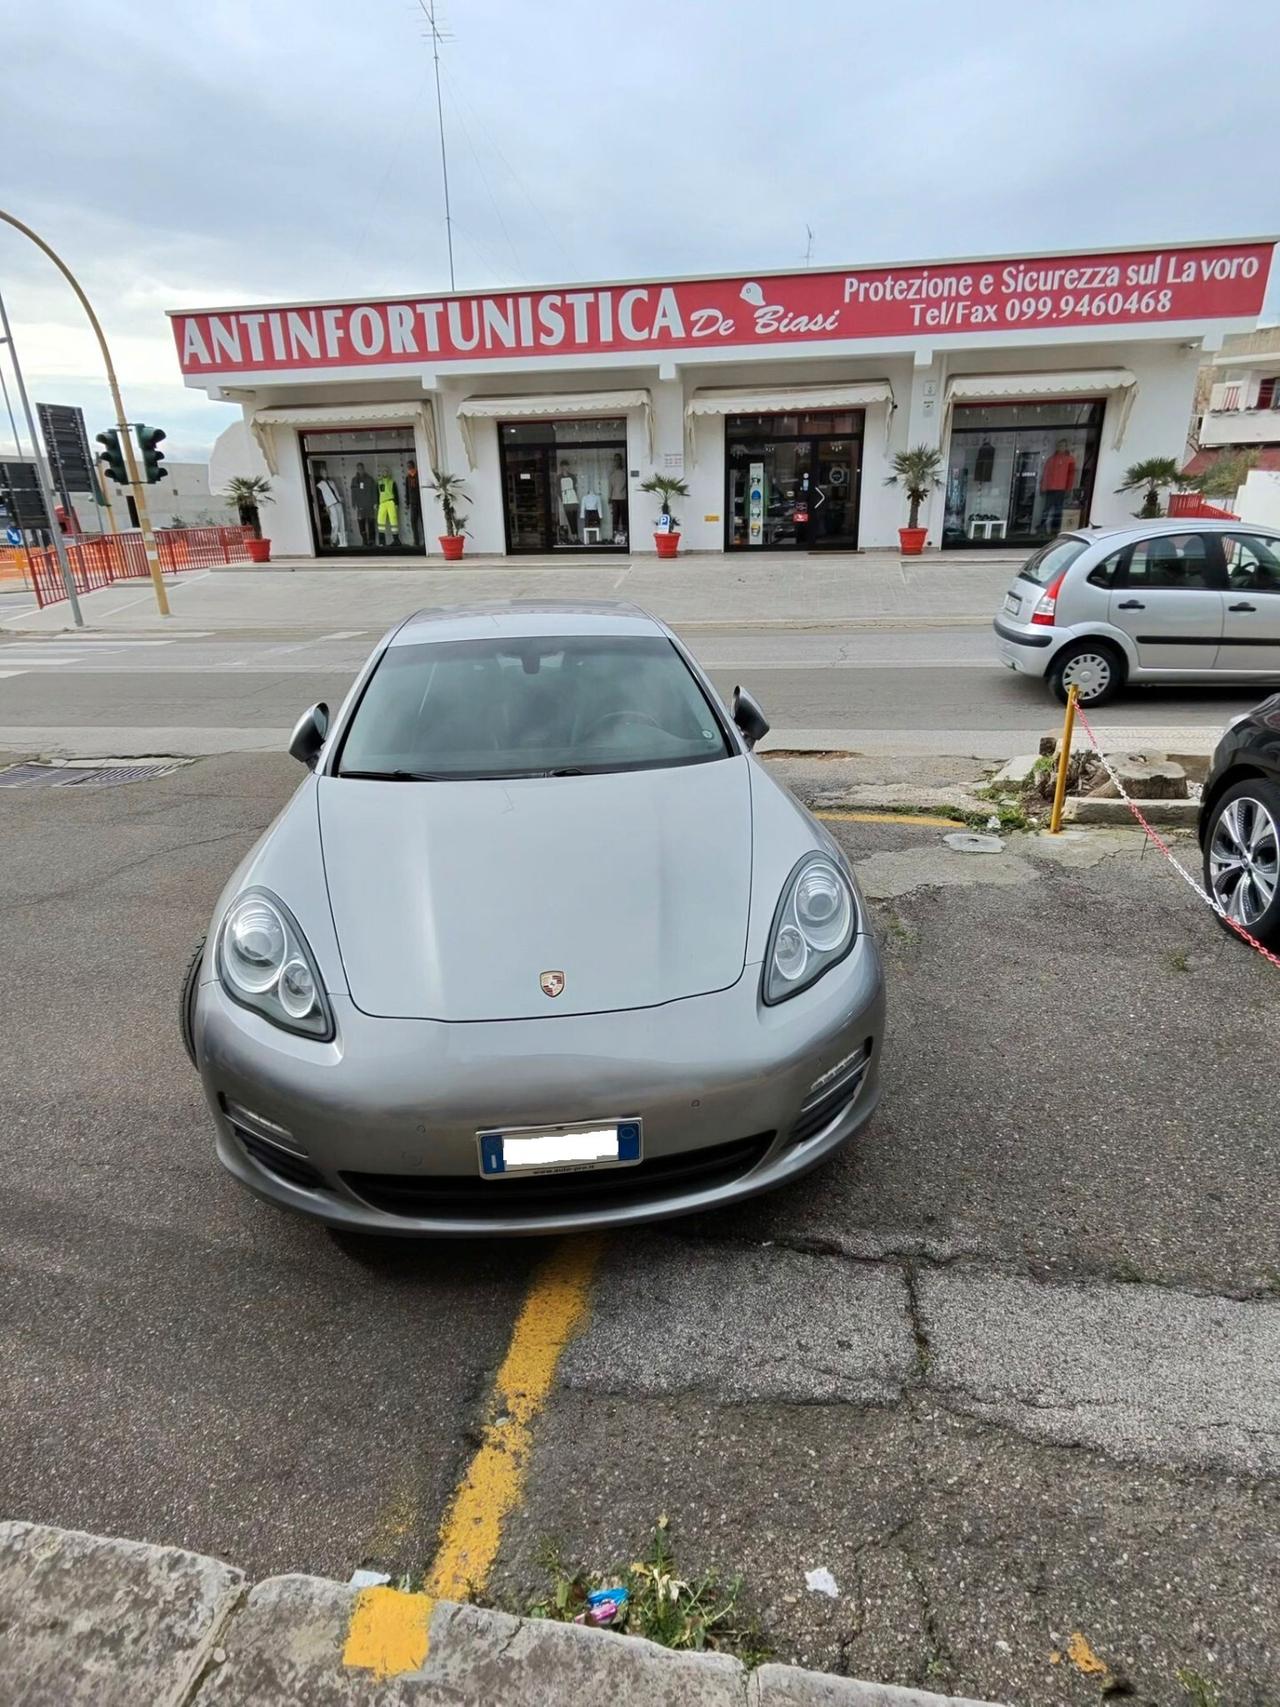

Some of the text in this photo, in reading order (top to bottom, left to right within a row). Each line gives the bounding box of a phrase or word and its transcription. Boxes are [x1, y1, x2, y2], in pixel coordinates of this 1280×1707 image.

[843, 255, 1259, 303] Protezione e Sicurezza sul Lavoro
[182, 287, 686, 365] ANTINFORTUNISTICA
[690, 304, 841, 337] De Biasi
[910, 289, 1172, 327] Tel/Fax 099.9460468
